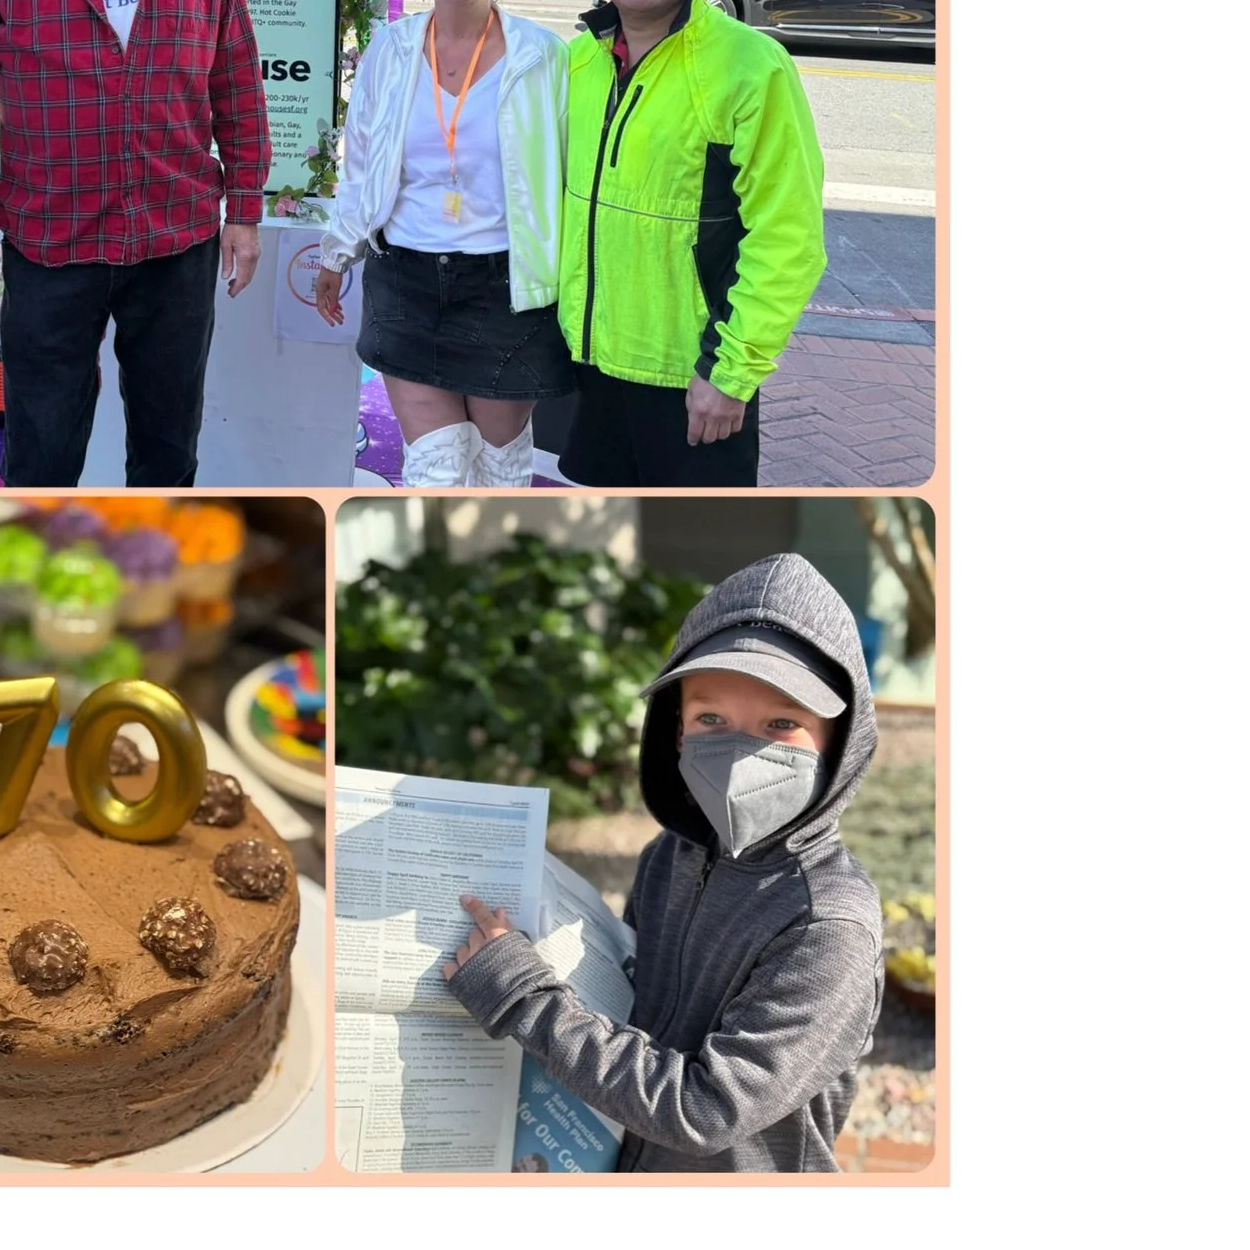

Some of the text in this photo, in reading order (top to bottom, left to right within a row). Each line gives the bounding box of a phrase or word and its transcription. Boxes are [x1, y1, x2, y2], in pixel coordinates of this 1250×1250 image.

[284, 0, 297, 7] Gay
[267, 20, 307, 28] community.
[287, 122, 301, 130] Gay,
[363, 797, 416, 809] ANNOUNCEMENTS
[543, 1099, 589, 1150] Health Plan
[551, 1093, 604, 1151] San Francisco
[535, 1124, 560, 1150] Our
